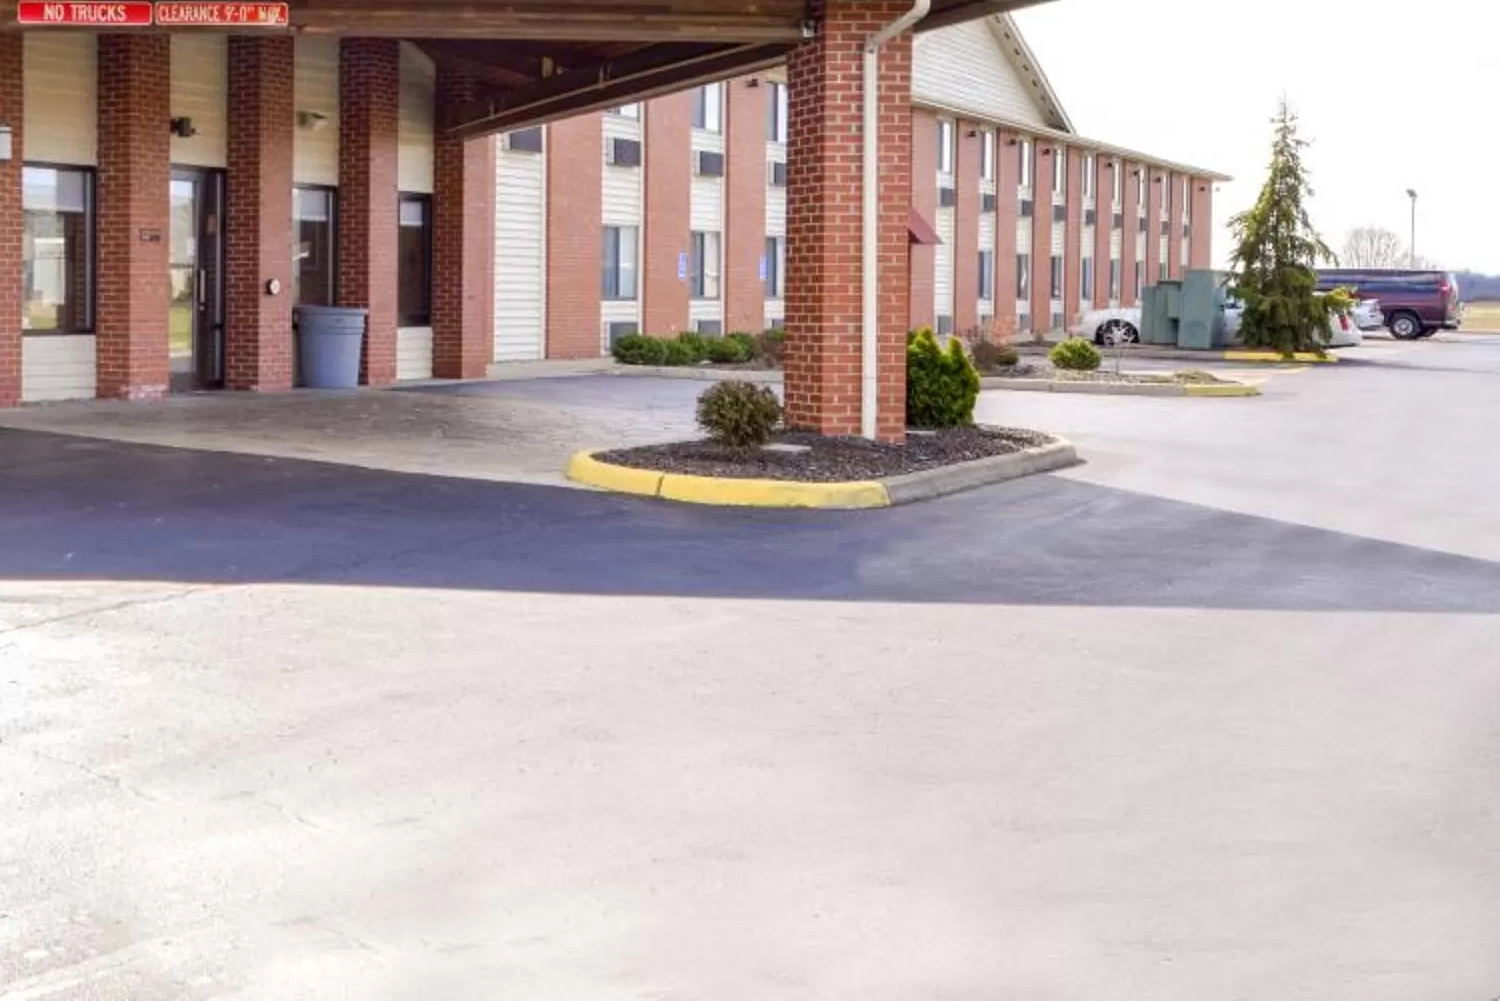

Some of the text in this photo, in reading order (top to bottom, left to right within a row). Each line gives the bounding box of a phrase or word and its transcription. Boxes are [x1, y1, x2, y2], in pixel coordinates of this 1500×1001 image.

[43, 3, 127, 22] NO TRUCKS
[159, 4, 221, 22] CLEARANCE
